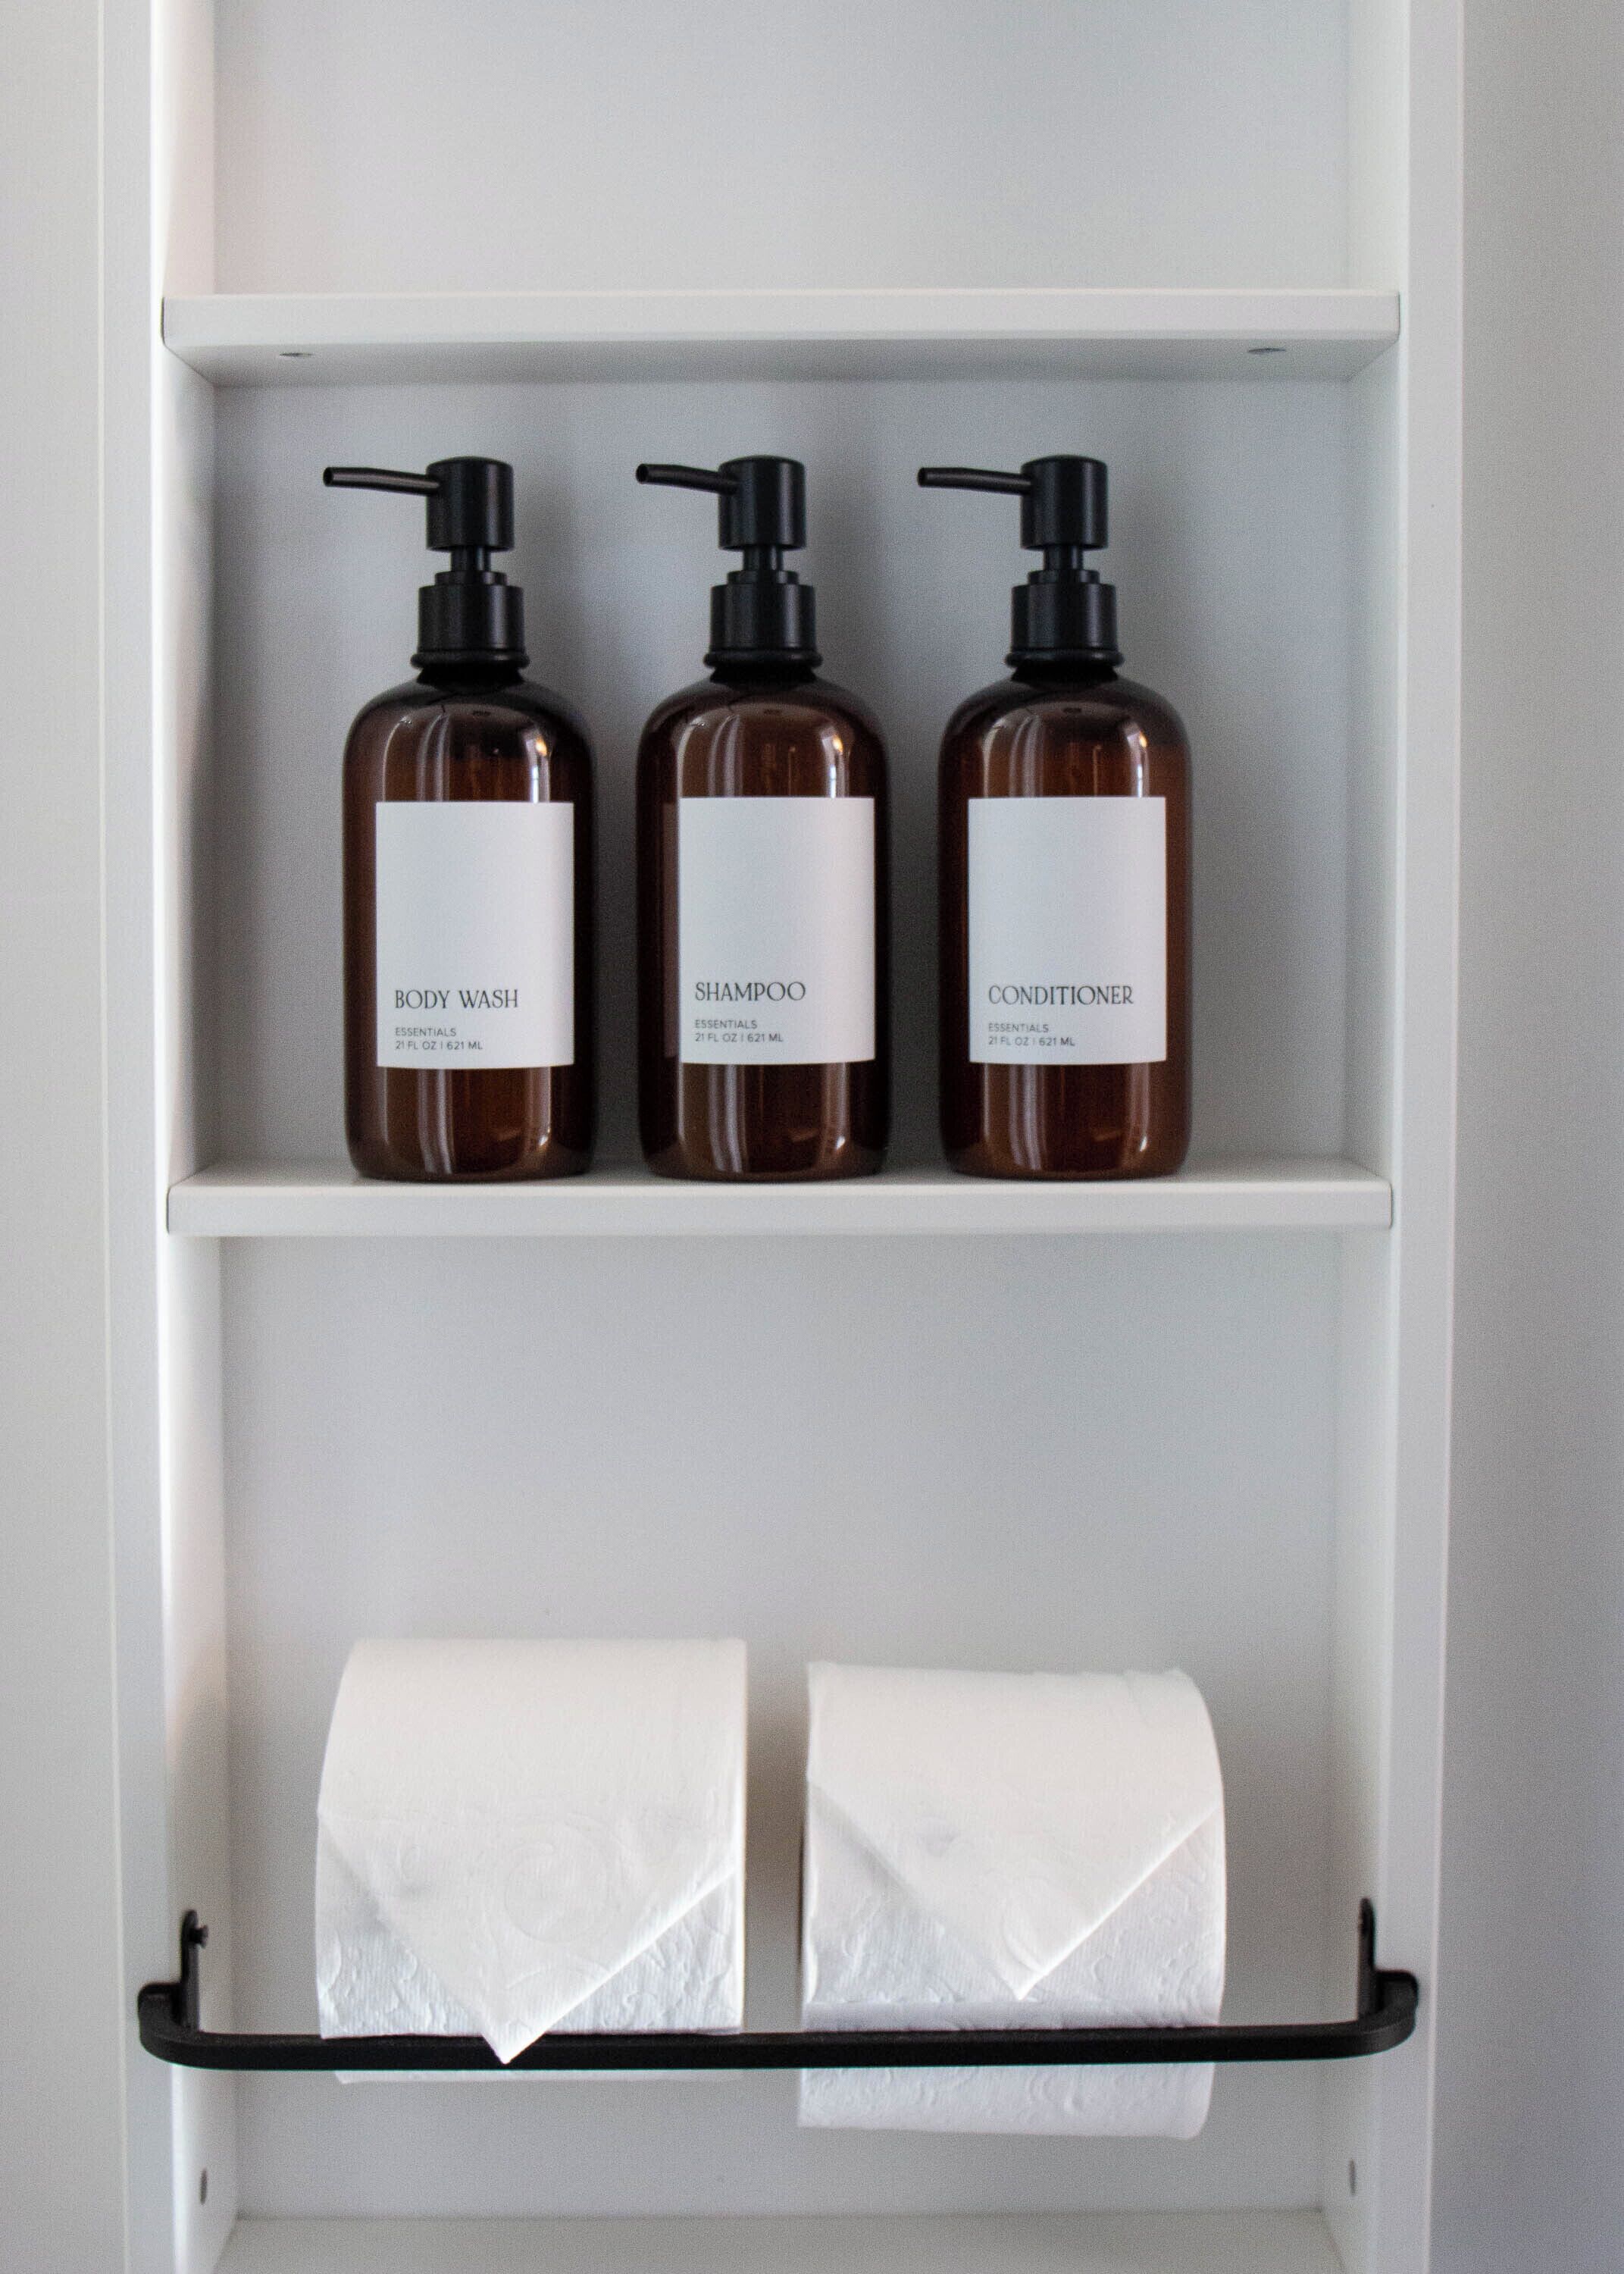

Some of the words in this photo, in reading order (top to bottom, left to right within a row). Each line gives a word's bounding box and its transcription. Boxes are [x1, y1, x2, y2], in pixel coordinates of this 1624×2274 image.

[695, 981, 806, 1002] SHAMPOO
[988, 985, 1134, 1006] CONDITIONER
[394, 988, 451, 1010] BODY
[458, 988, 518, 1009] WASH
[695, 1019, 758, 1029] ESSENTIALS
[988, 1023, 1050, 1033] ESSENTIALS
[395, 1026, 457, 1038] ESSENTIALS
[695, 1032, 705, 1043] 21
[708, 1032, 719, 1043] FL
[722, 1032, 737, 1043] OZ
[747, 1032, 765, 1043] 621
[768, 1032, 784, 1043] ML
[395, 1041, 405, 1051] 21
[408, 1041, 419, 1051] FL
[421, 1041, 437, 1051] OZ
[446, 1041, 465, 1051] 621
[468, 1041, 483, 1051] ML
[988, 1036, 997, 1046] 21
[1000, 1036, 1012, 1046] FL
[1015, 1036, 1029, 1046] OZ
[1039, 1036, 1057, 1046] 621
[1060, 1036, 1075, 1047] ML
